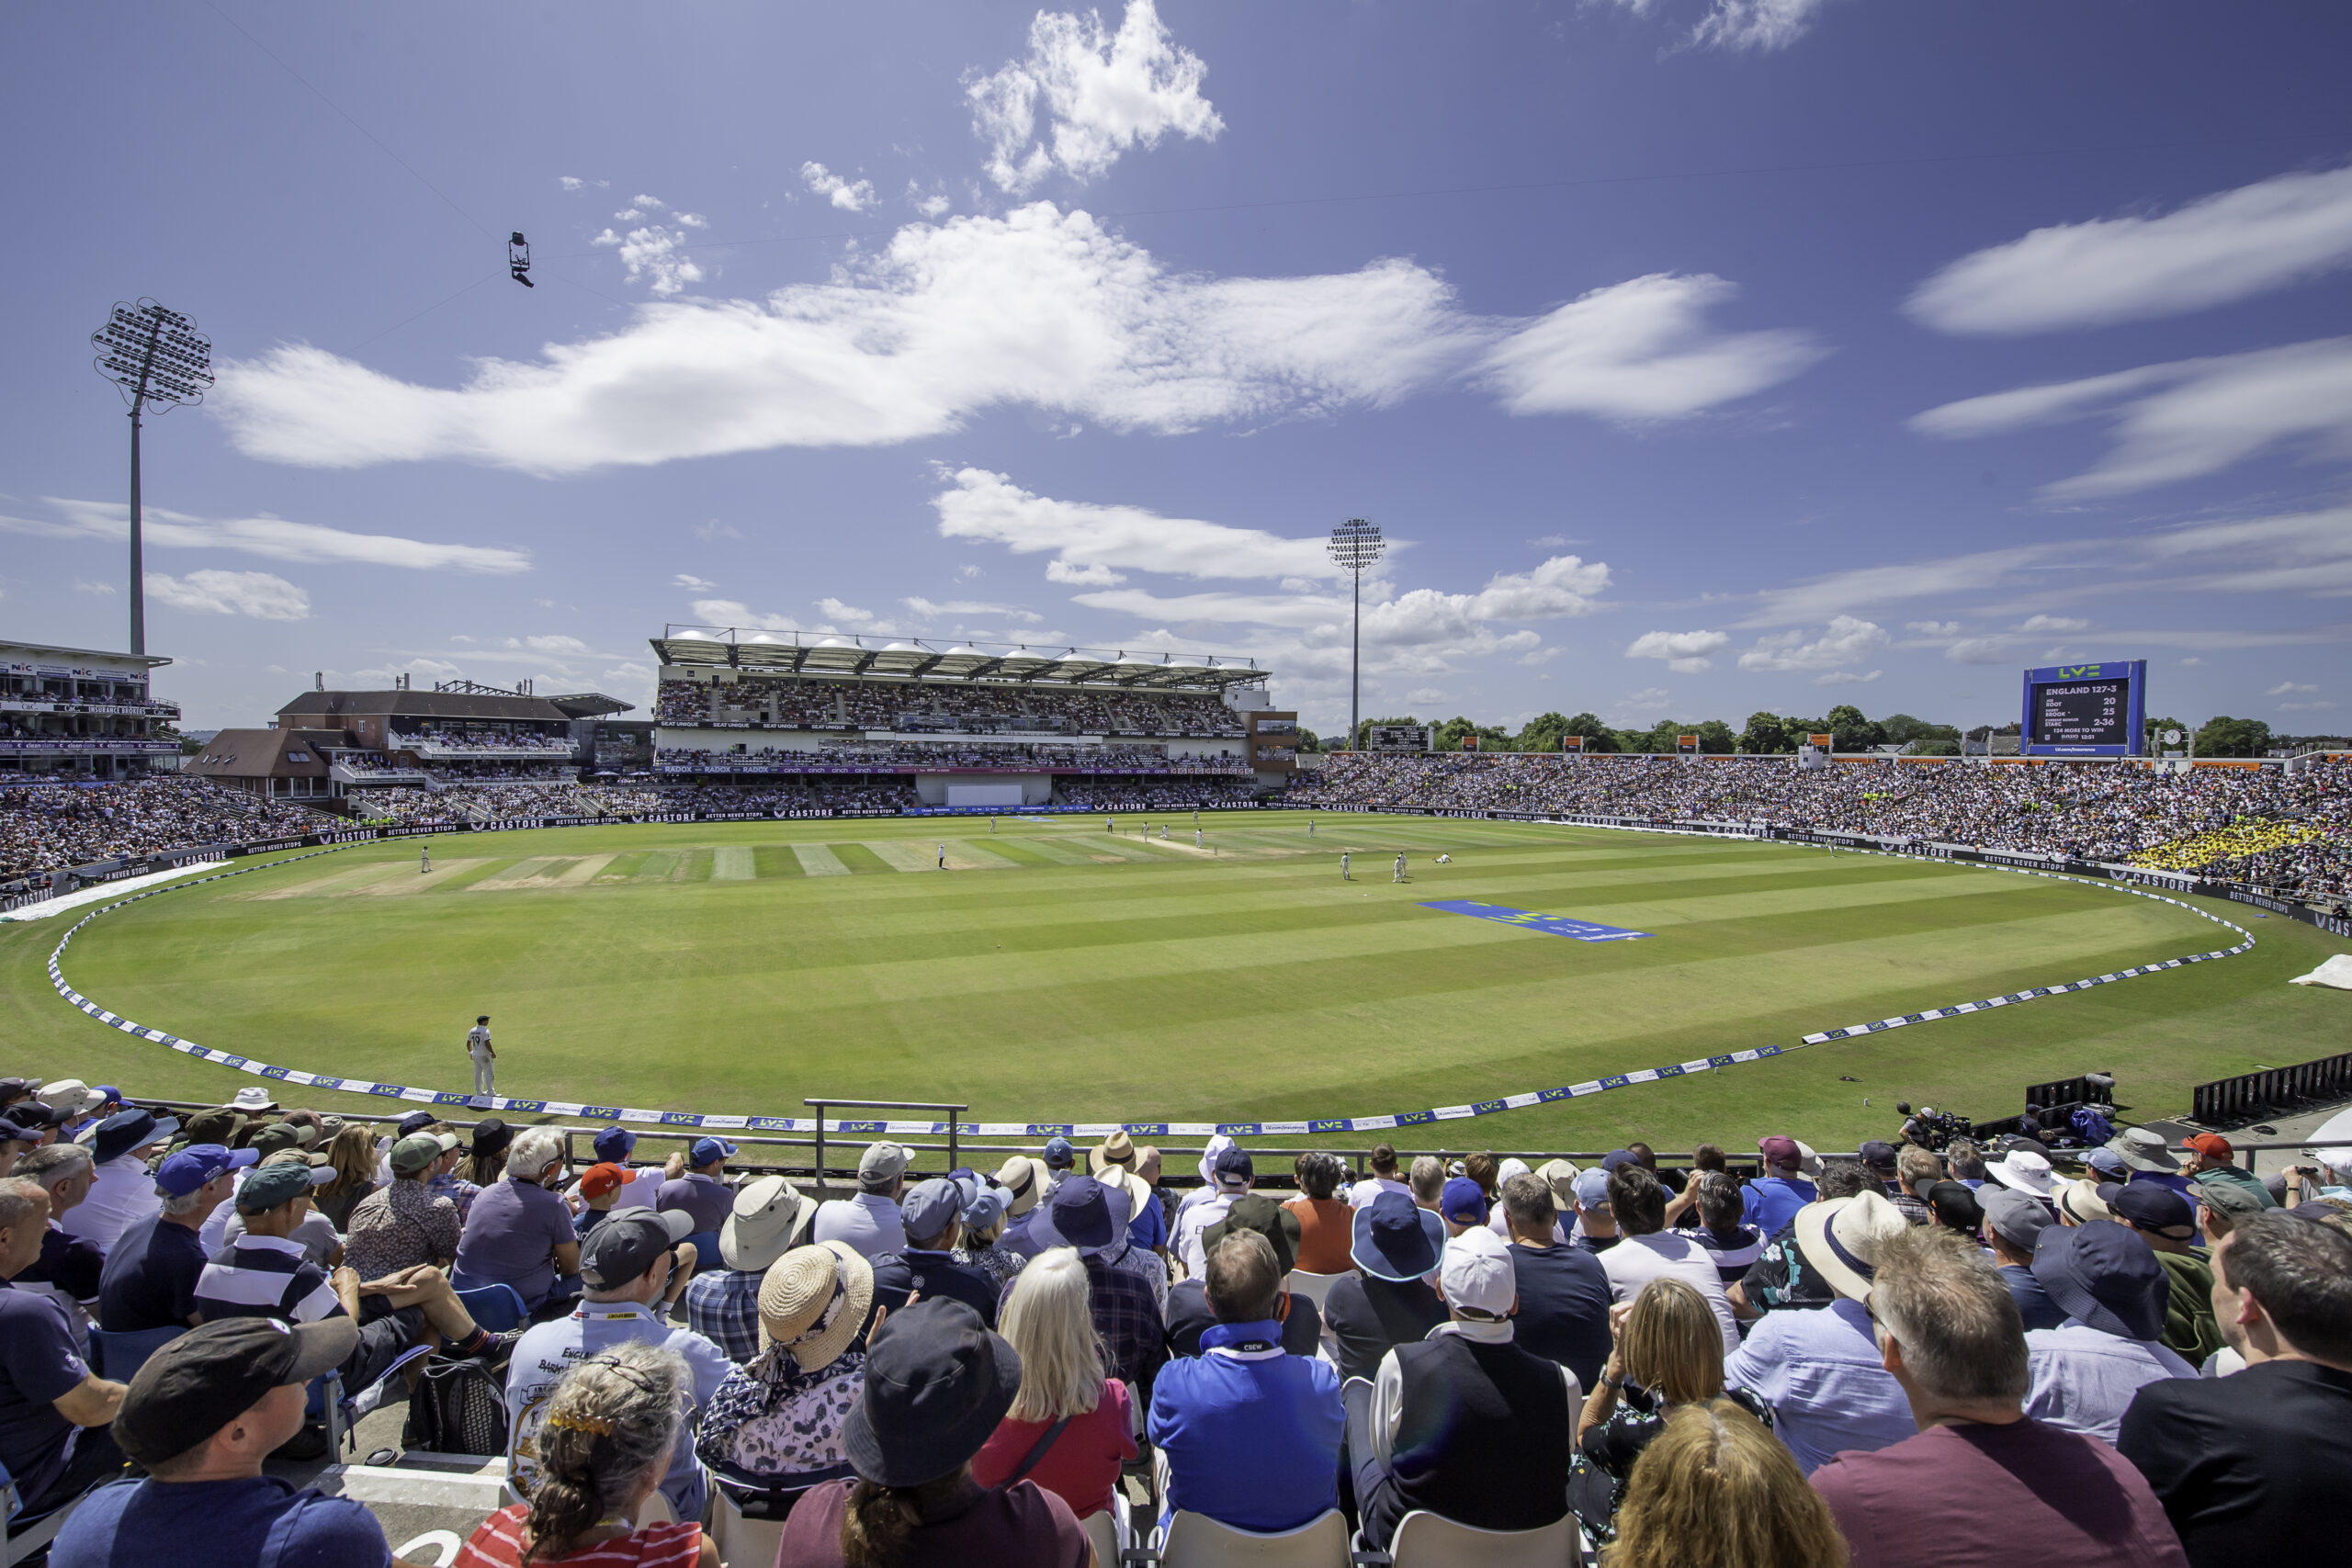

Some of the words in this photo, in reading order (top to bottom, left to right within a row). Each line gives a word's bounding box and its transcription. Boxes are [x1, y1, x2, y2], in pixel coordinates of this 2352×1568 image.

[649, 813, 696, 822] CASTORE
[1448, 810, 1488, 819] CASTORE
[490, 820, 544, 830] CASTORE
[1576, 817, 1621, 826] CASTORE
[335, 829, 378, 843] CASTORE
[1724, 827, 1775, 838] CASTORE
[1788, 833, 1810, 841] BETTER
[1834, 837, 1855, 846] STOPS
[248, 845, 266, 854] BETTER
[1899, 844, 1953, 858] CASTORE
[186, 851, 226, 865] CASTORE
[1985, 855, 2010, 865] BETTER
[2013, 859, 2037, 868] NEVER
[2041, 862, 2065, 871] STOPS
[112, 869, 130, 879] NEVER
[131, 866, 149, 875] STOPS
[2133, 873, 2193, 893] CASTORE
[18, 887, 54, 908] CASTORE
[2230, 891, 2253, 903] BETTER
[2255, 895, 2270, 908] NEVER
[2273, 900, 2288, 914] STOPS
[2328, 918, 2352, 937] CAS
[562, 1347, 594, 1359] ENGLA
